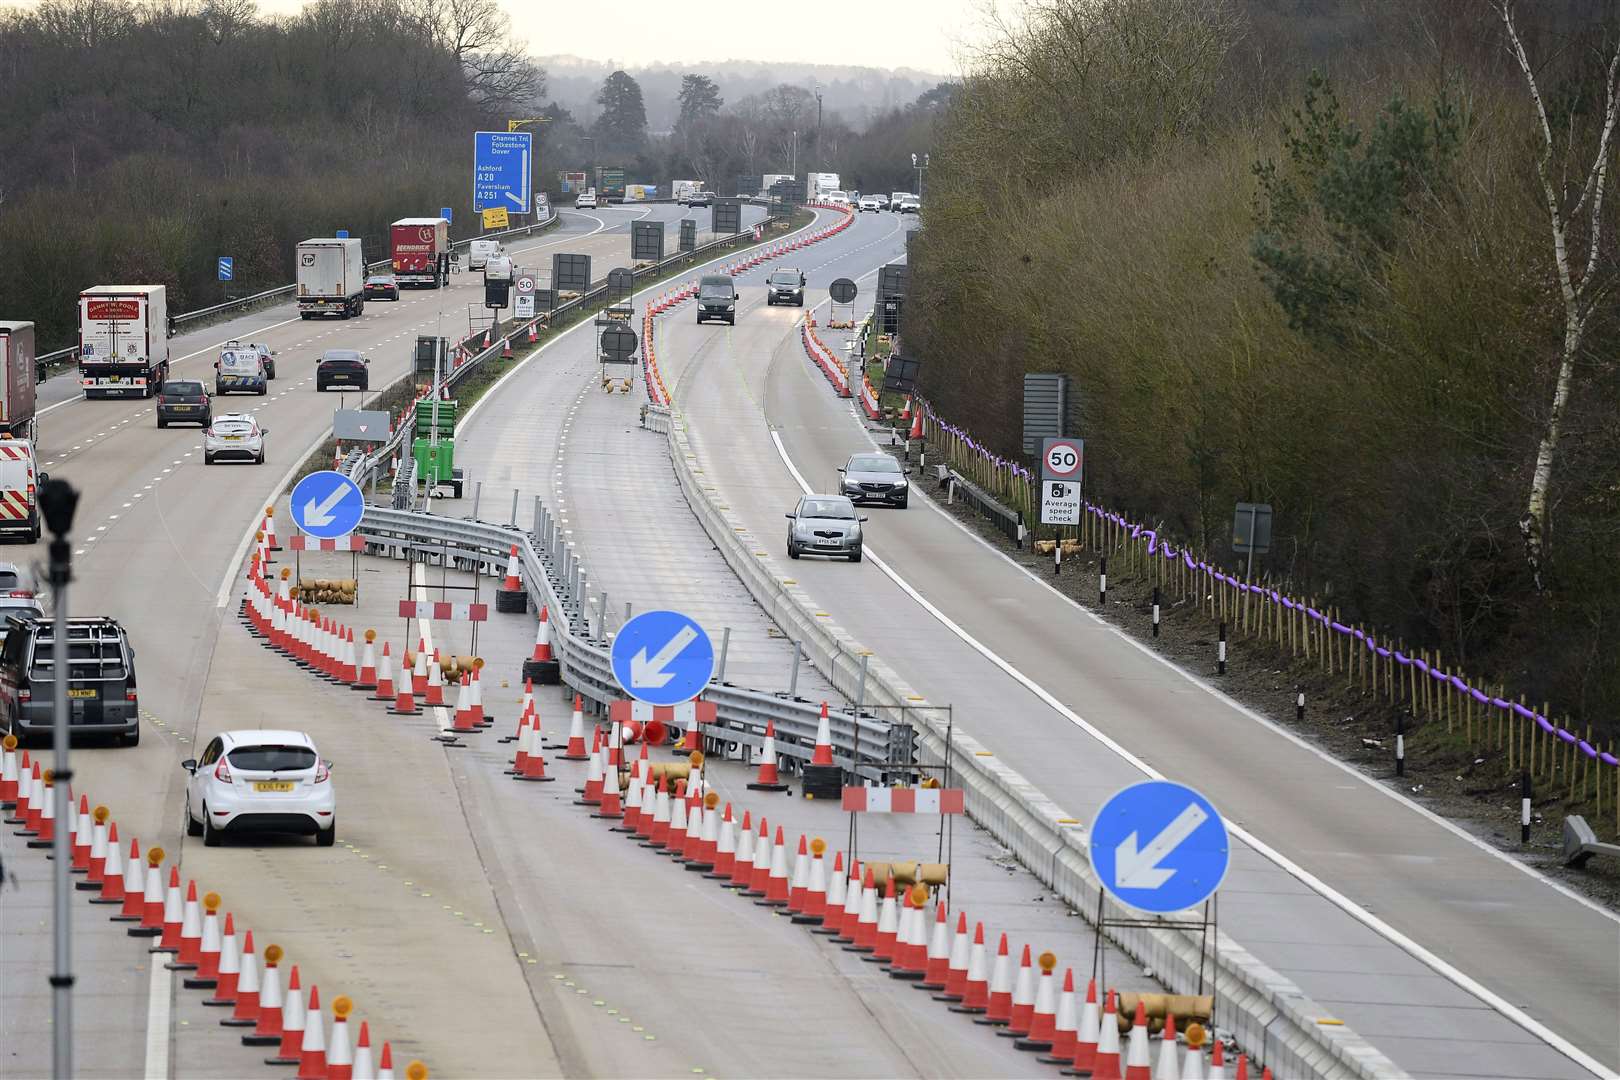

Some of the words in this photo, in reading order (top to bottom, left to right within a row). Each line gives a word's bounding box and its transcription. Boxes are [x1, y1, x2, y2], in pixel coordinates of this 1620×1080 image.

[519, 281, 532, 289] 50
[1051, 452, 1076, 467] 50
[1045, 500, 1077, 508] Average
[1049, 508, 1072, 516] speed
